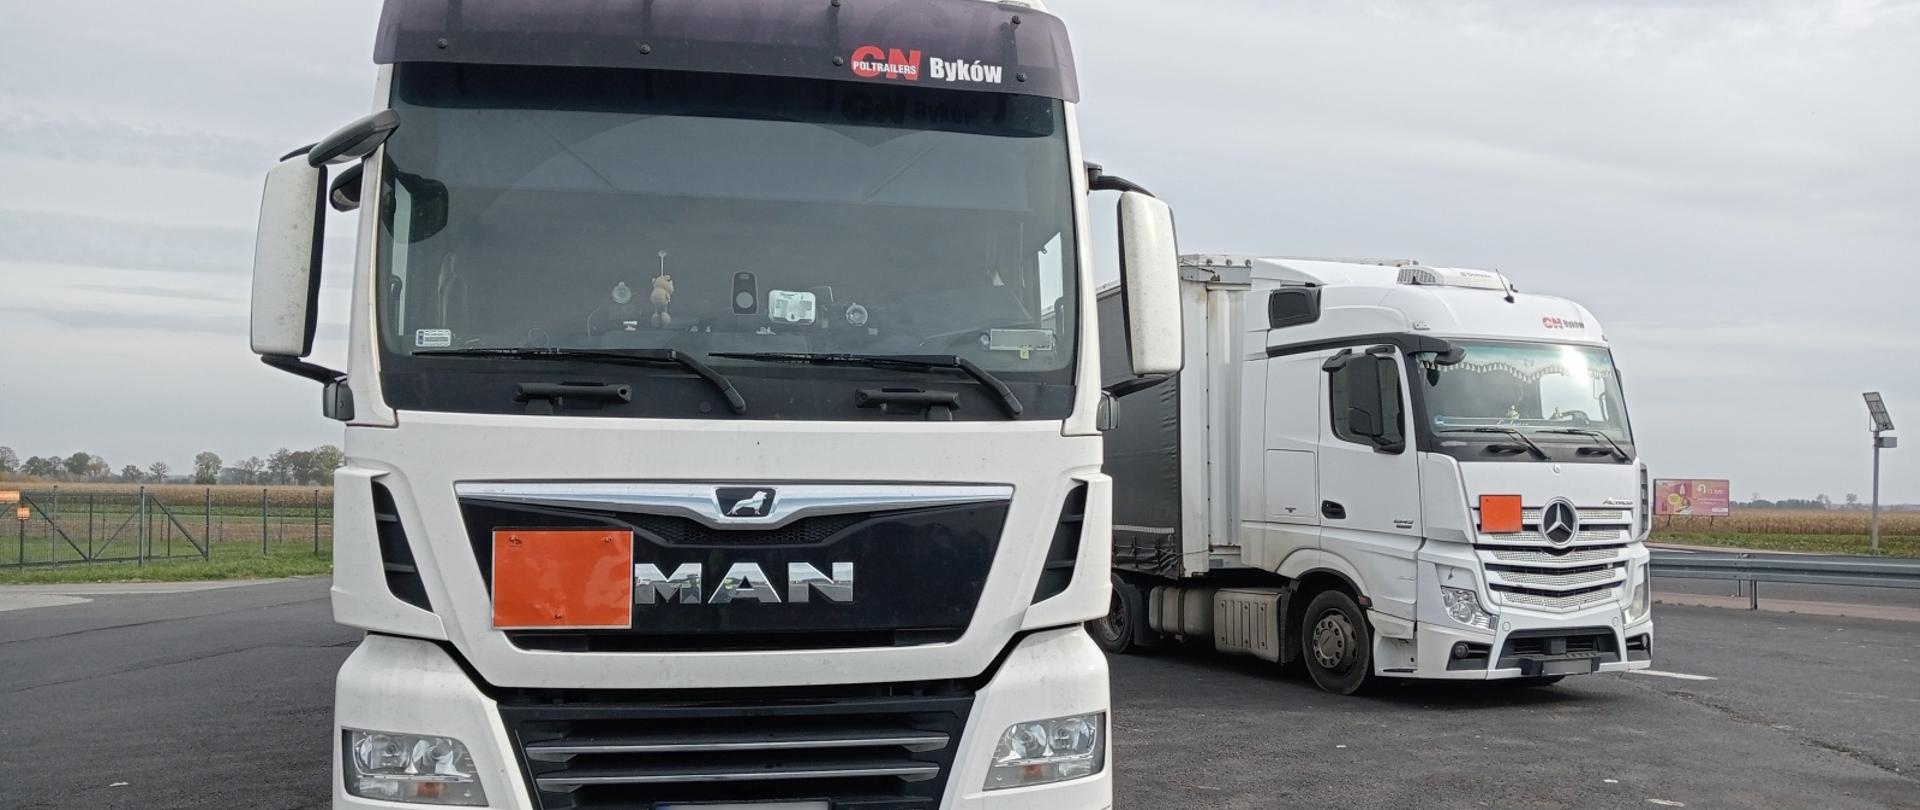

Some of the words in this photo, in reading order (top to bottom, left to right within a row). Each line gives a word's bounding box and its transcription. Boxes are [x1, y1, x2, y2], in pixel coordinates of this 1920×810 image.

[852, 61, 917, 75] POLTRAILERS
[929, 57, 1003, 84] Byków
[634, 562, 854, 604] MAN
